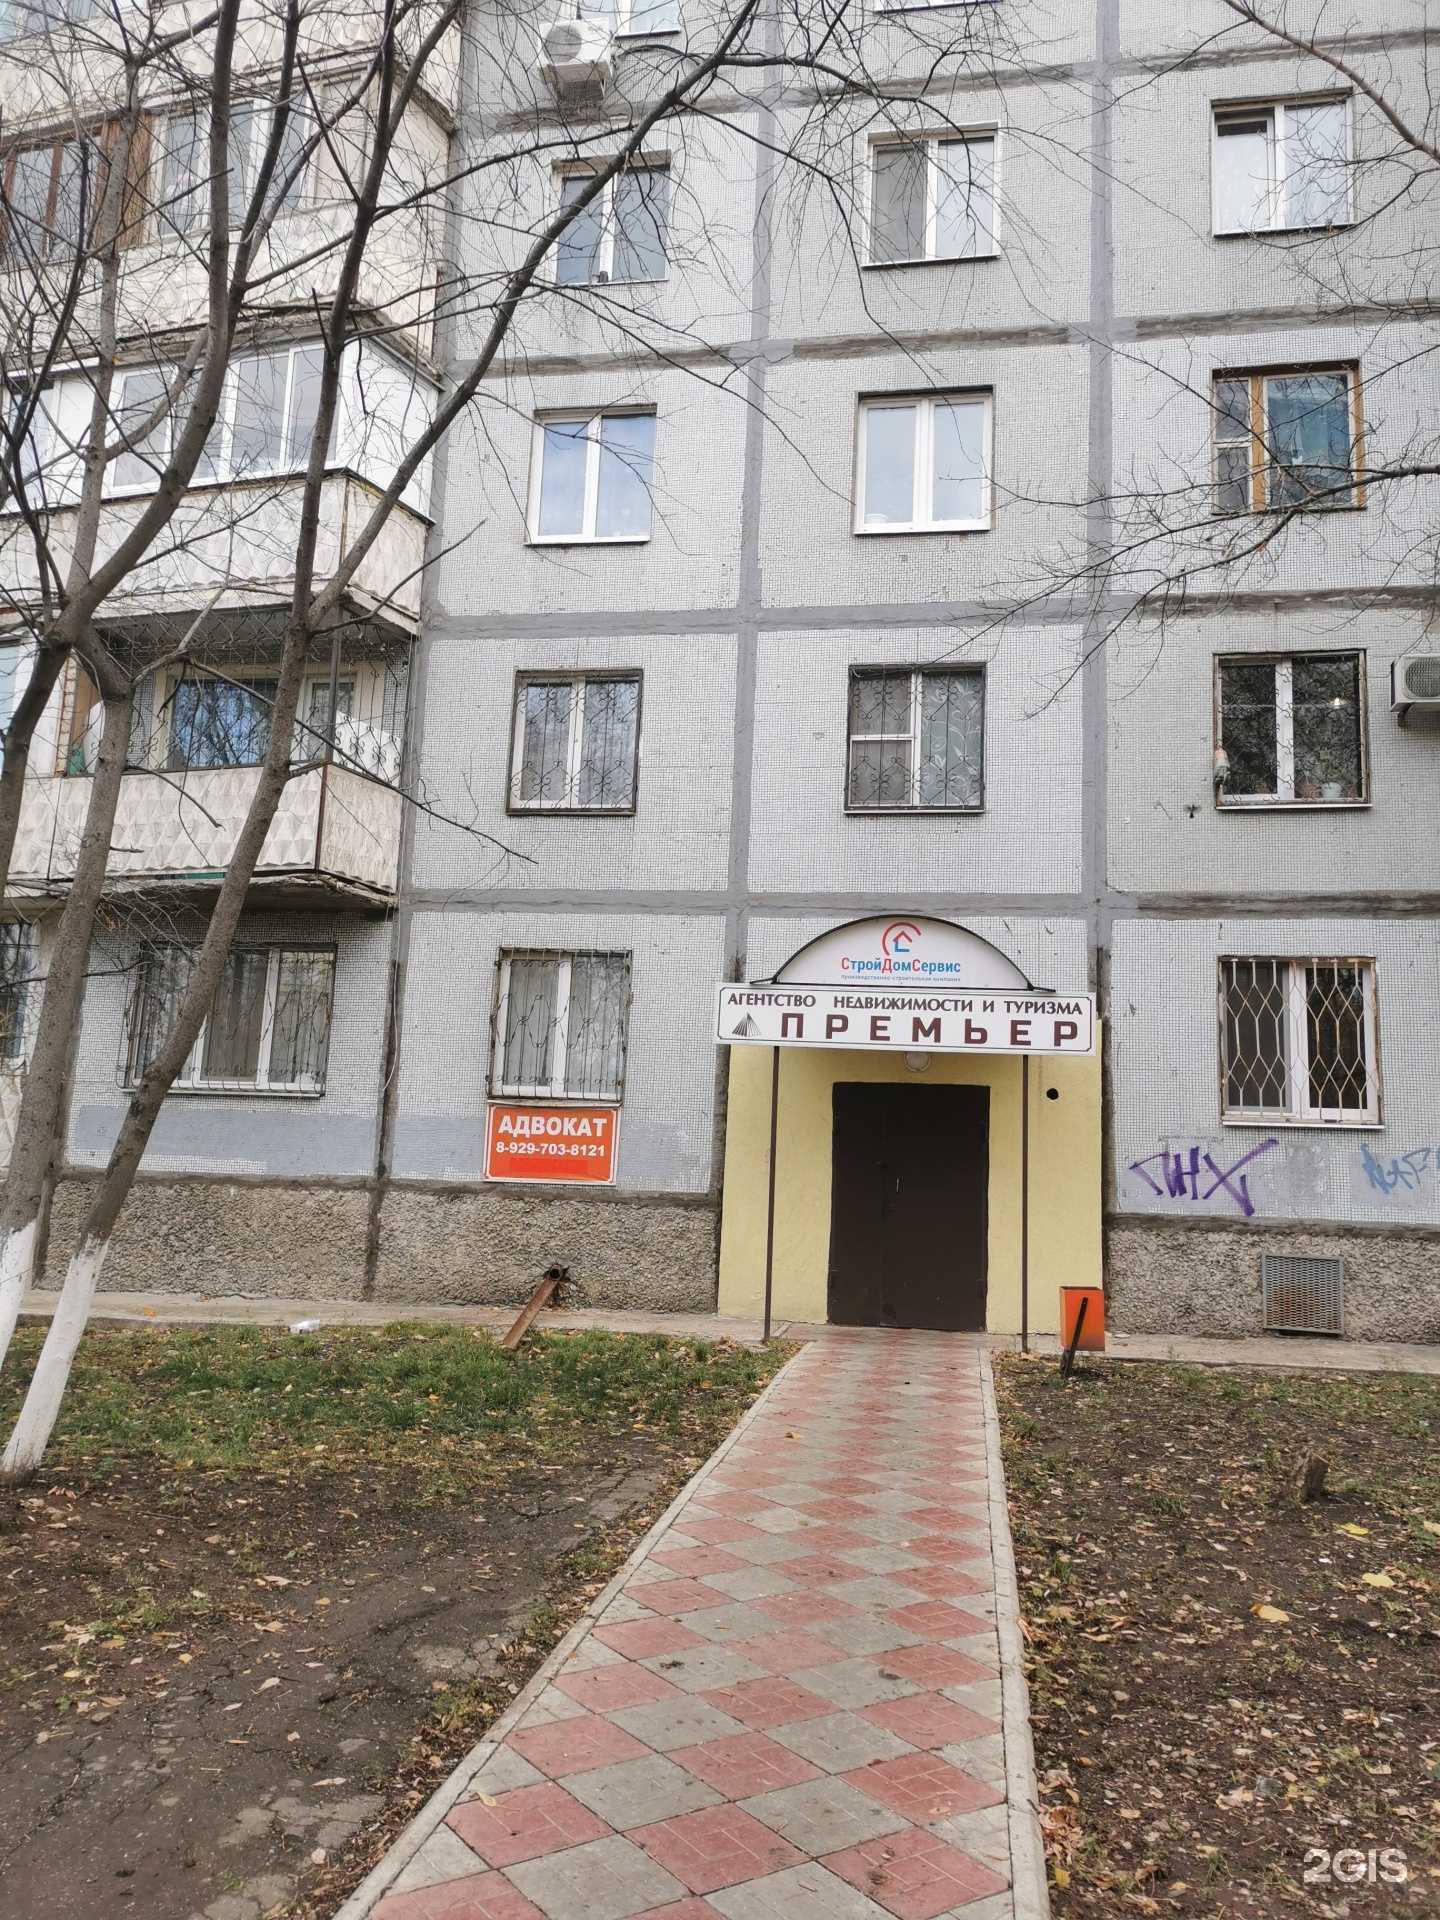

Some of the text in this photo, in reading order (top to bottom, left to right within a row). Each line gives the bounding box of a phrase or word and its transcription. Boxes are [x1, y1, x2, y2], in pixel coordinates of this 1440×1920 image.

[841, 957, 961, 975] СтройДомСервис
[727, 993, 1083, 1015] АГЕНТСТВО НЕДВИЖИМОСТИ И ТУРИЗМА
[781, 1012, 1079, 1047] ПРЕМЬЕР
[498, 1115, 608, 1138] АДВОКАТ
[496, 1141, 606, 1157] 8-929-703-8121
